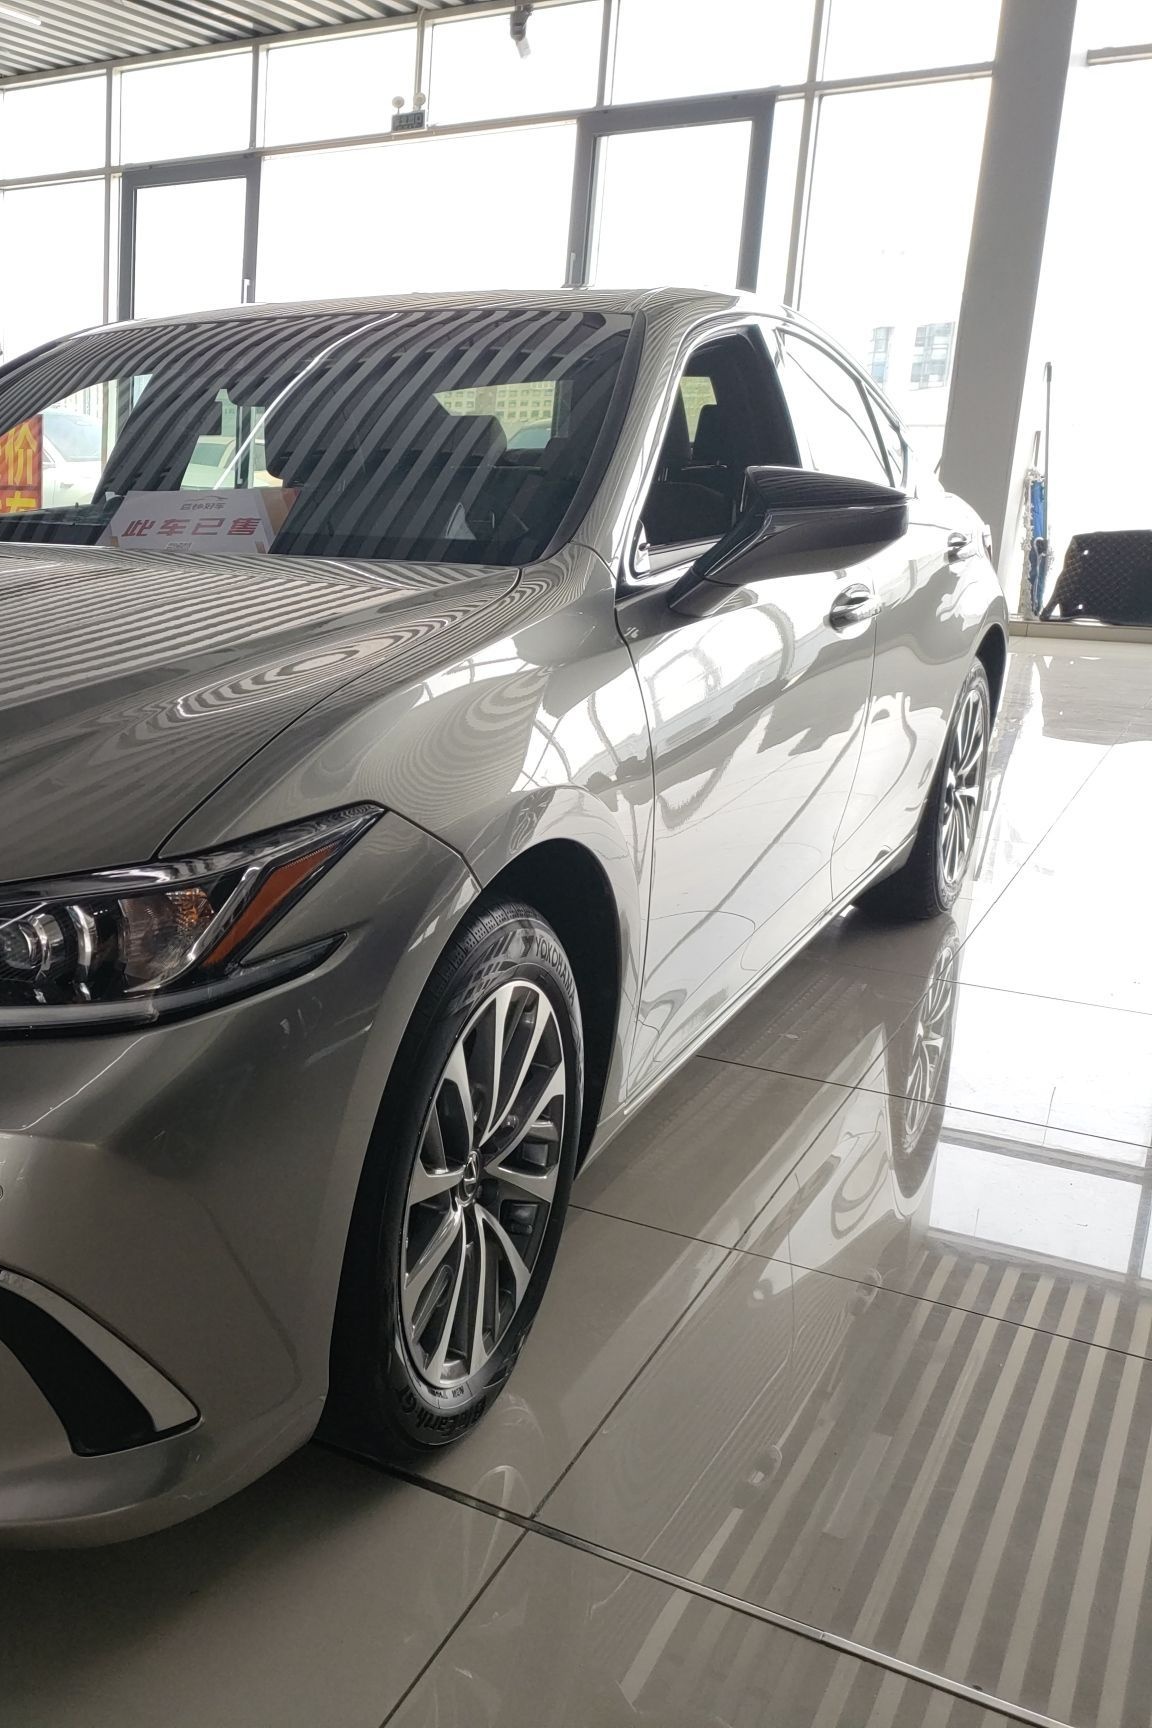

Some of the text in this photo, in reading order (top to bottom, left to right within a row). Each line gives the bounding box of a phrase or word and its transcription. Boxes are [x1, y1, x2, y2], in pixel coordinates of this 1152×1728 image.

[120, 517, 263, 537] 此车已售
[535, 936, 576, 1007] YOKOHAMA
